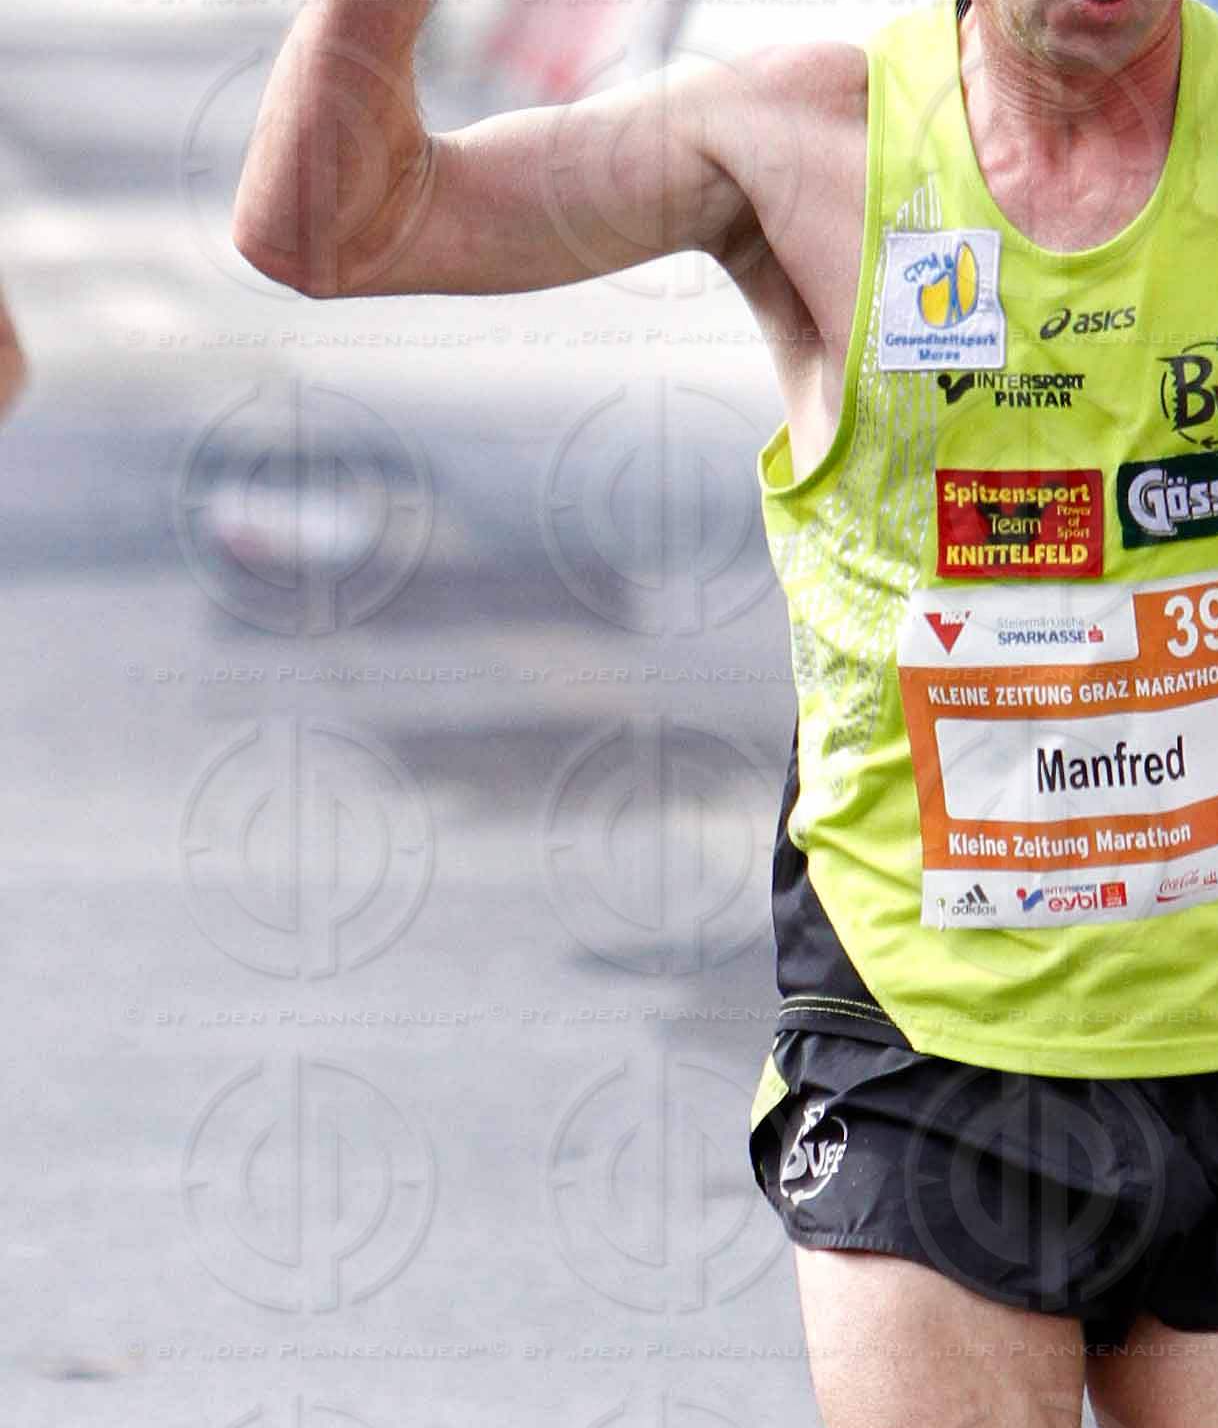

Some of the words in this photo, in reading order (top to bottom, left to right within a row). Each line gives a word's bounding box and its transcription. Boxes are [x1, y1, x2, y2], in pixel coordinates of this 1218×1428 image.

[976, 373, 1085, 391] INTERSPORT
[995, 390, 1072, 409] PINTAR
[944, 481, 1091, 508] Spitzensport
[989, 515, 1043, 536] Team
[946, 544, 1089, 566] KNITTELFELD
[997, 629, 1087, 646] SPARKASSE
[927, 684, 991, 707] KLEINE
[994, 684, 1074, 708] ZEITUNG
[1078, 679, 1130, 705] GRAZ
[1036, 734, 1187, 795] Manfred
[948, 834, 1008, 858] Kleine
[1012, 834, 1090, 860] Zeitung
[1095, 822, 1192, 854] Marathon
[951, 902, 998, 917] adidas
[1048, 891, 1098, 912] eybl
